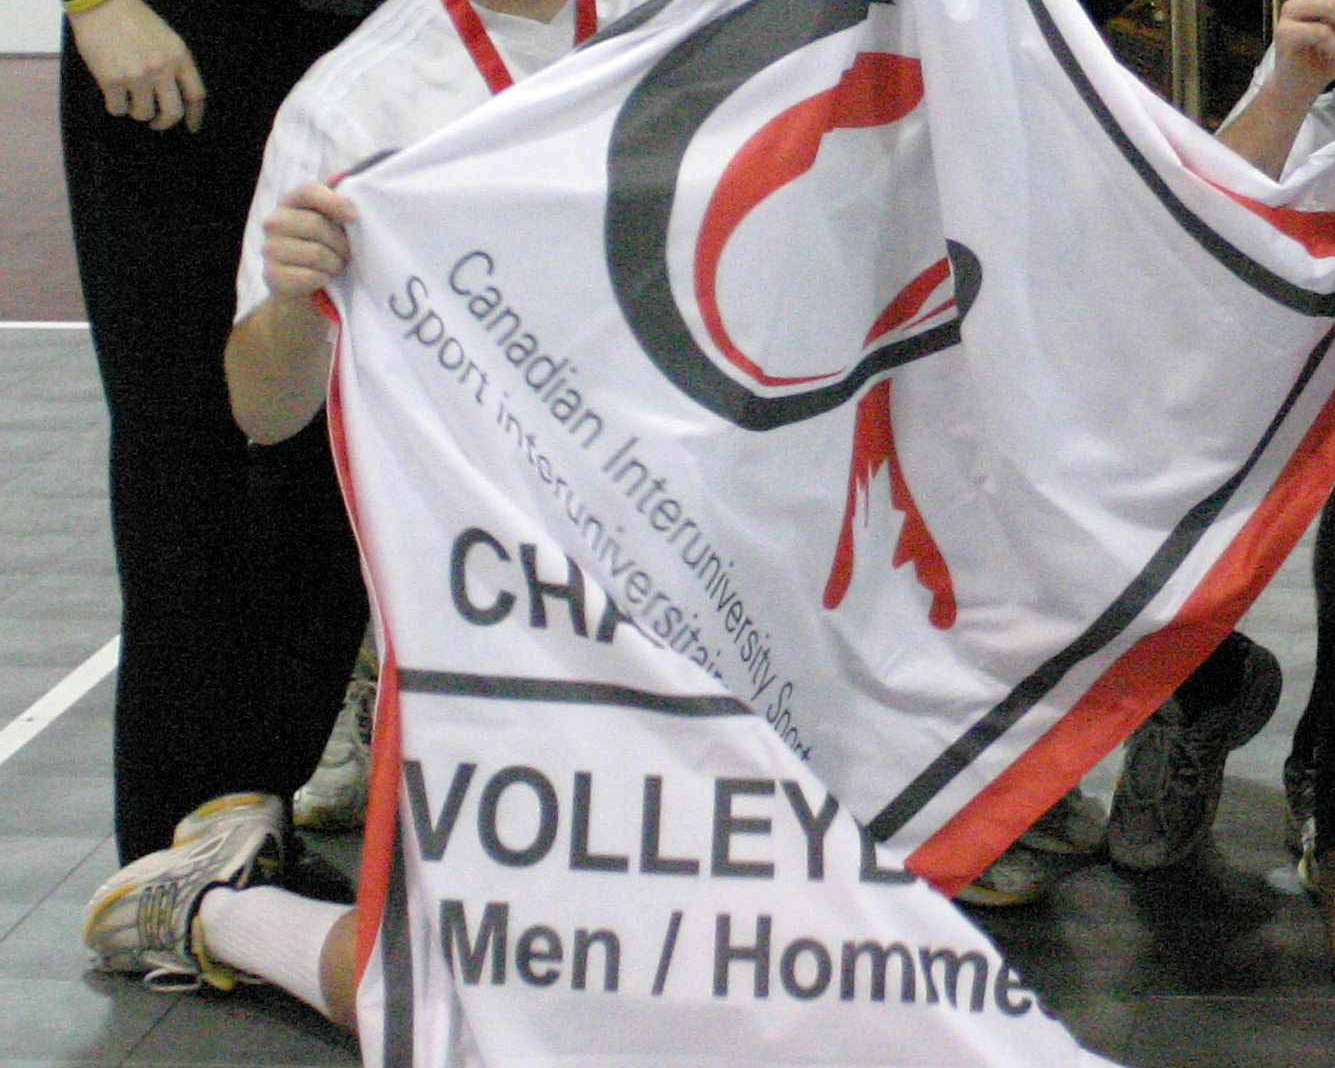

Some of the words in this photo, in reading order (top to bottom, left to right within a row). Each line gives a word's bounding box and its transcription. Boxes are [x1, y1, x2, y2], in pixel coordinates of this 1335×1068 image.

[388, 274, 490, 405] Sport
[448, 250, 605, 450] Canadian
[603, 436, 777, 700] Interuniversity
[438, 899, 622, 994] Men
[651, 911, 684, 997] /
[711, 912, 1042, 1018] Homme
